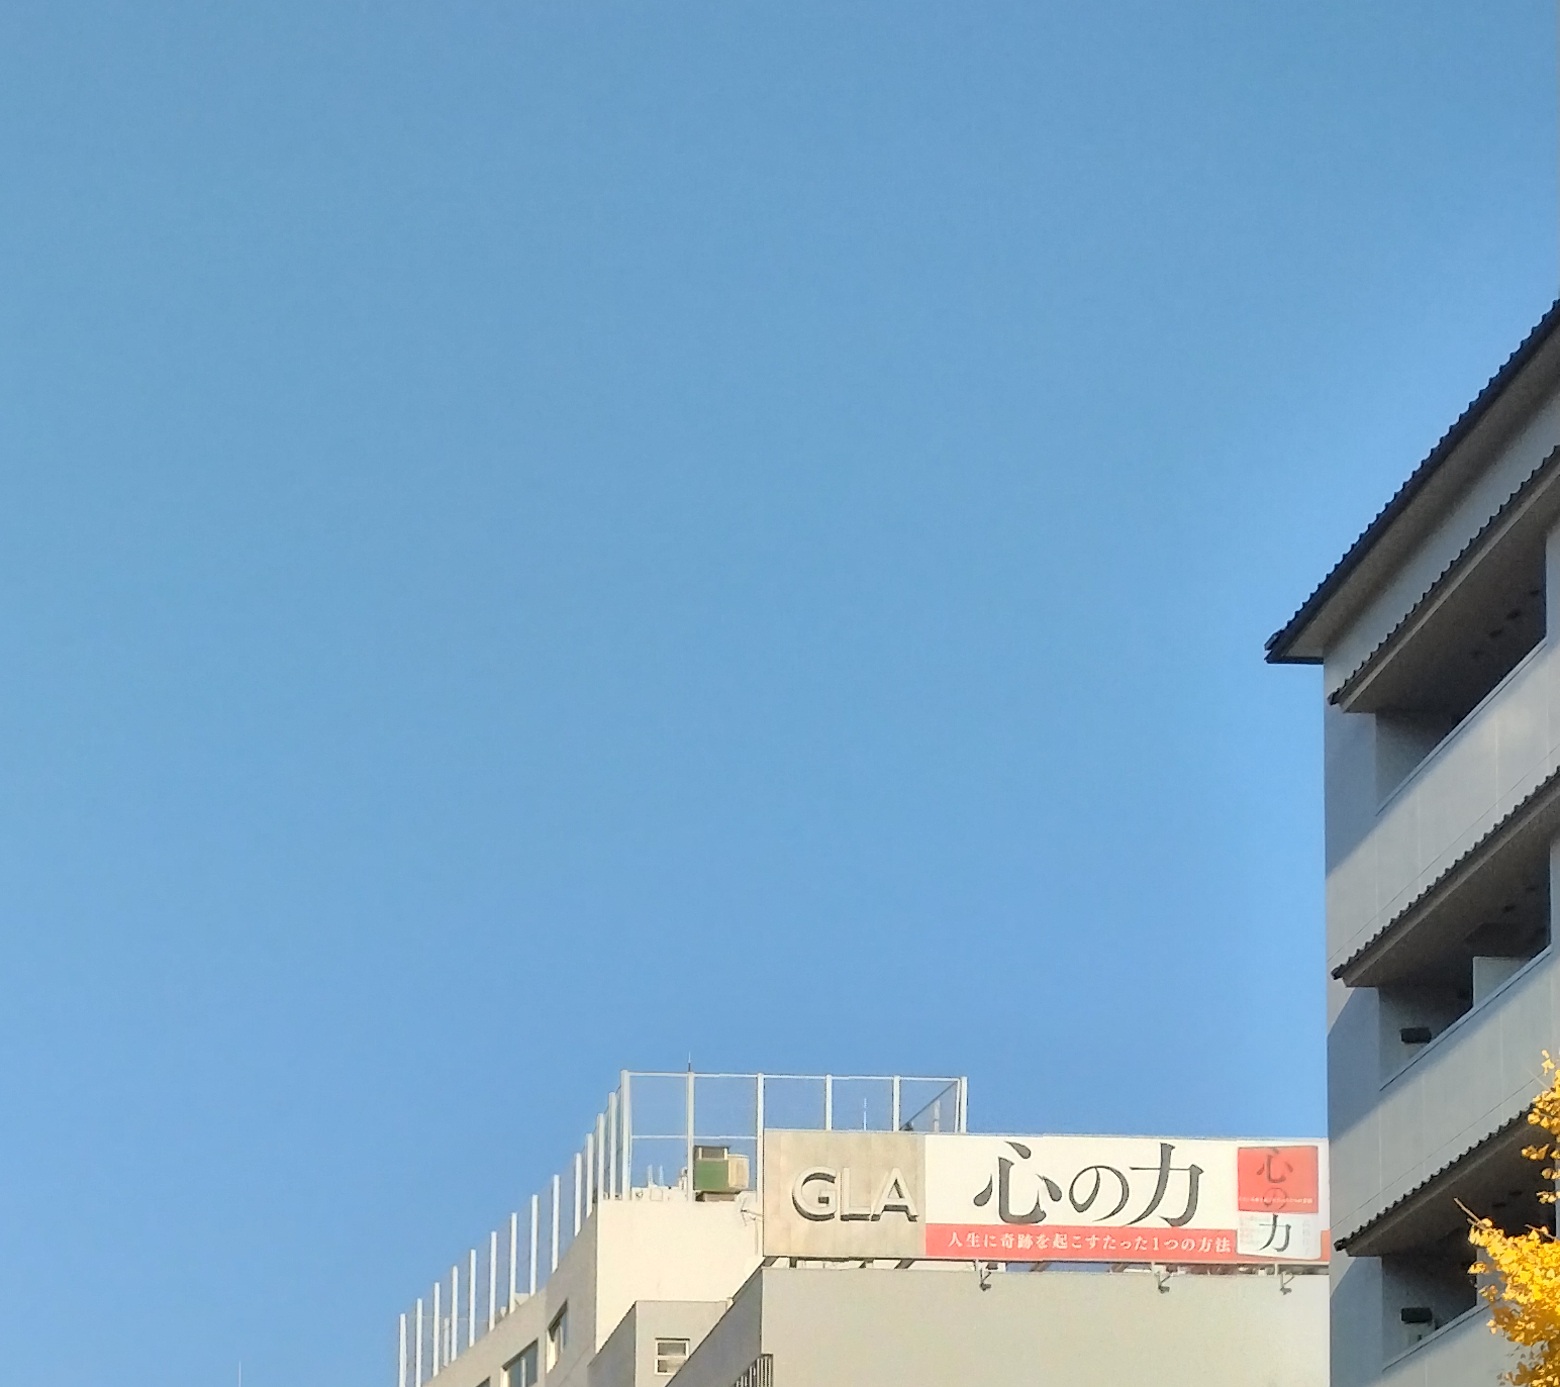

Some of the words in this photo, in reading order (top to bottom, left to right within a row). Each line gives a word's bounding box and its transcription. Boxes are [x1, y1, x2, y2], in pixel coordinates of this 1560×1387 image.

[792, 1165, 919, 1222] GLA
[972, 1140, 1205, 1228] 心の力
[947, 1231, 1233, 1253] 人生に奇跡を起こすたった1つの方法
